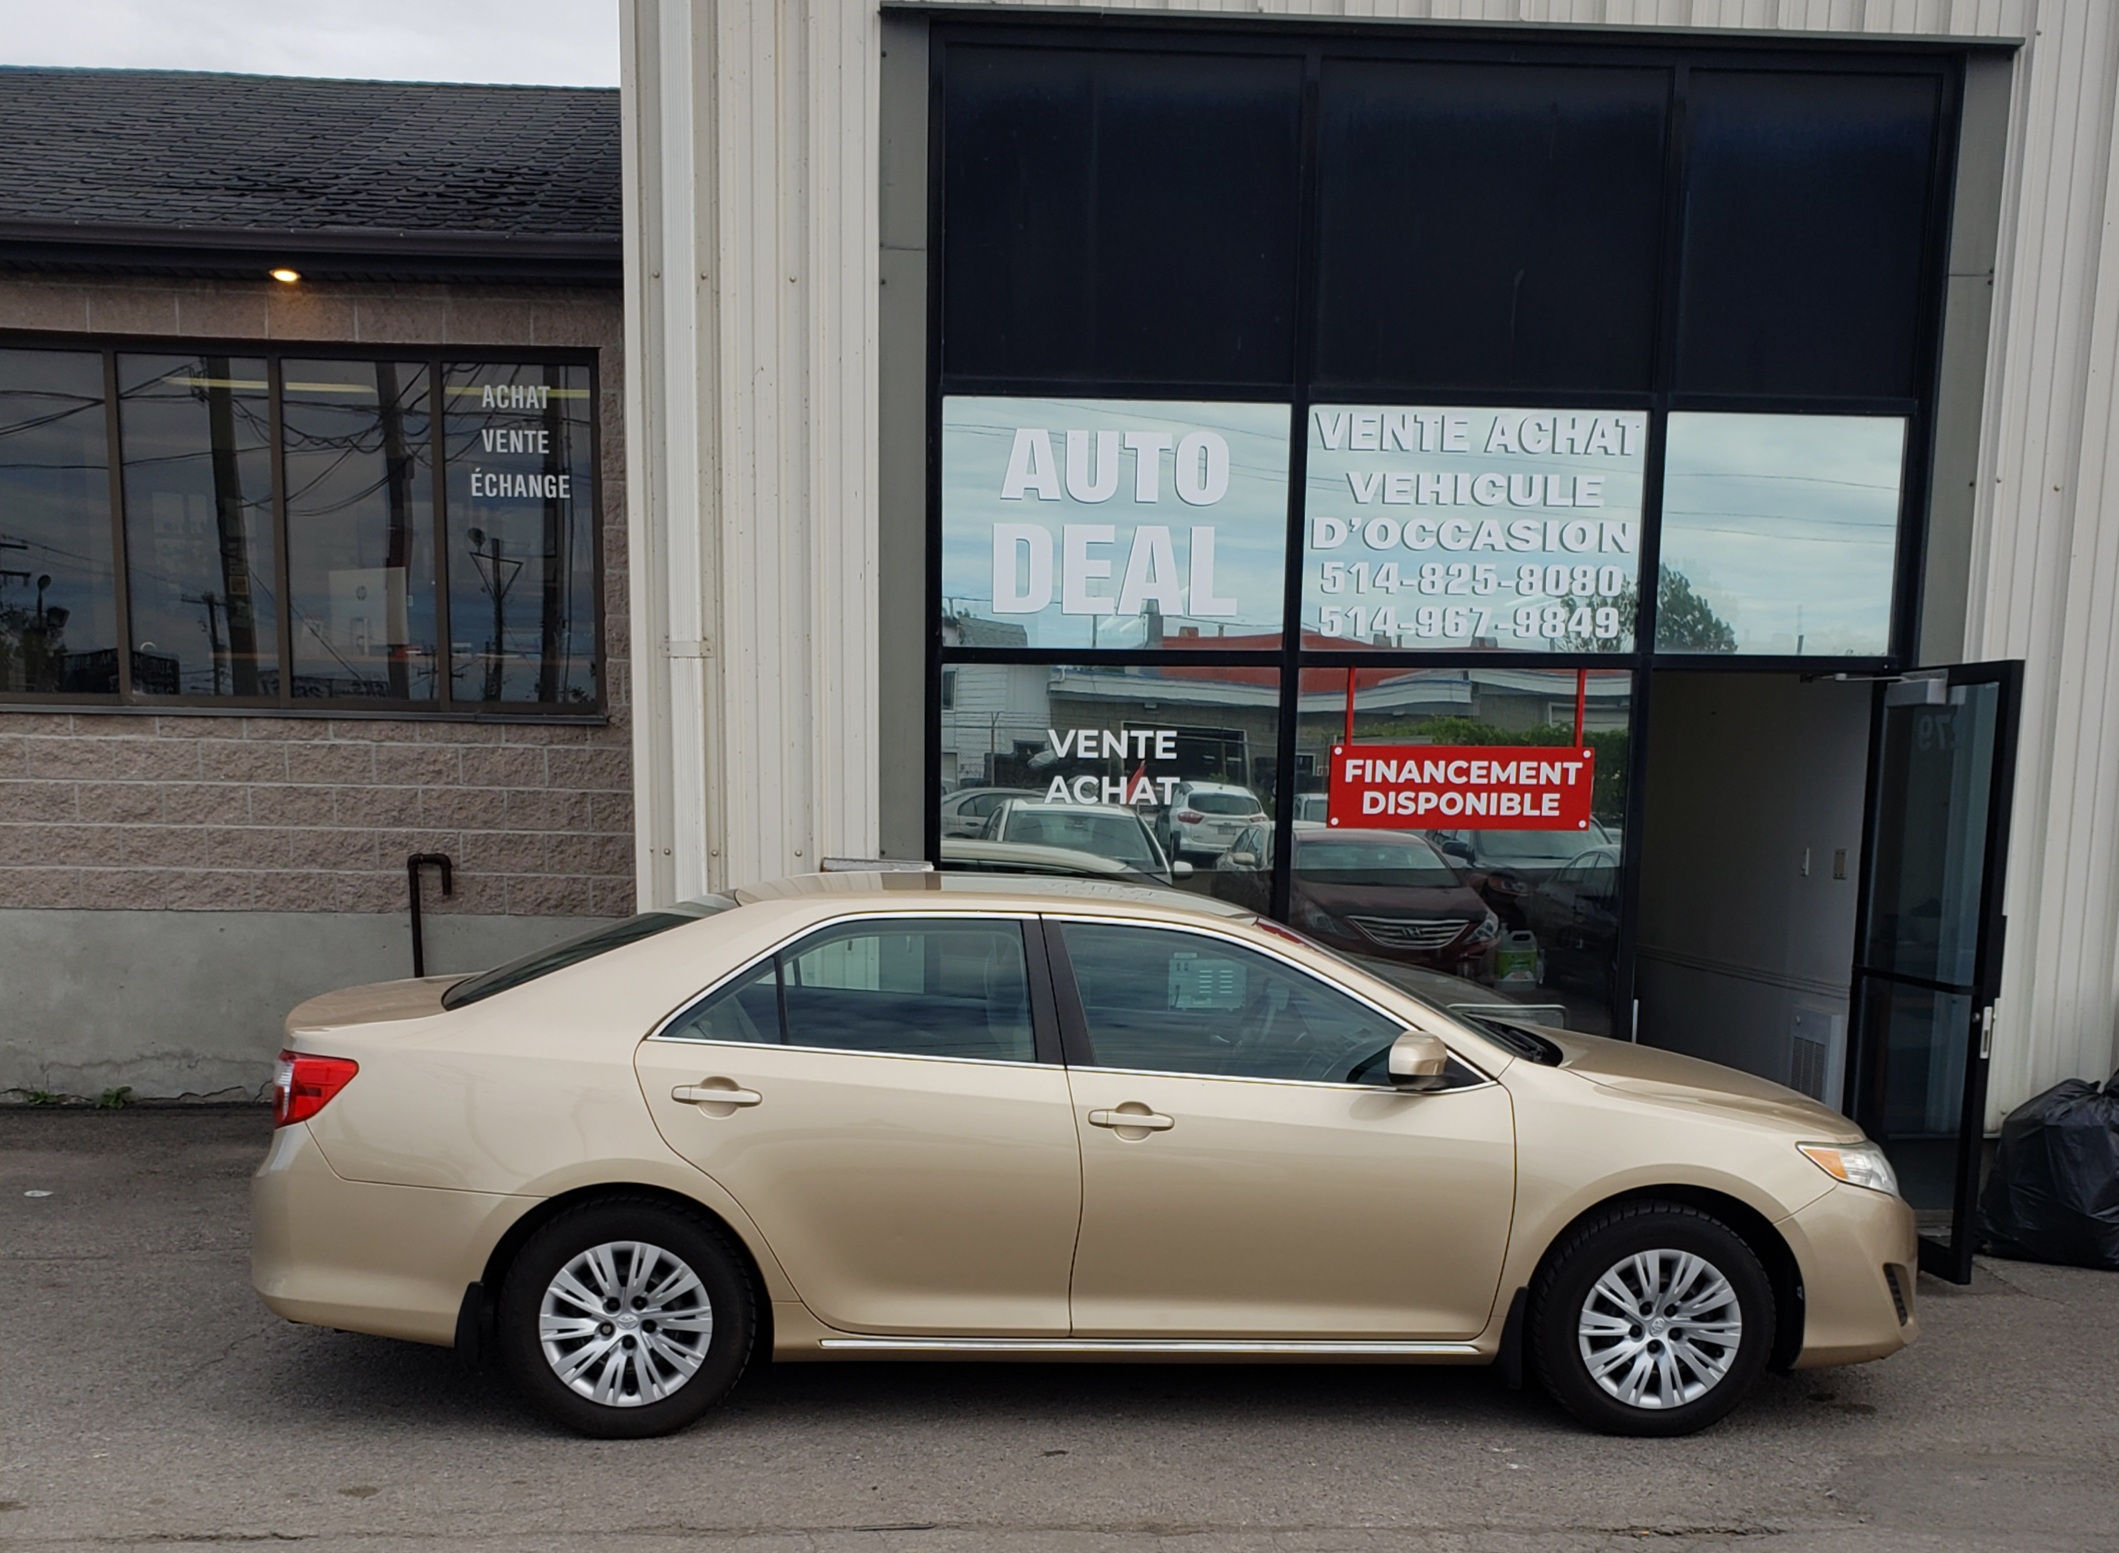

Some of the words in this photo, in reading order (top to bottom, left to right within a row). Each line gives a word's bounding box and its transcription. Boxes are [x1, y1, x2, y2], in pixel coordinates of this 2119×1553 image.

[482, 385, 551, 409] ACHAT
[482, 429, 550, 454] VENTE
[1315, 412, 1471, 452] VENTE
[1484, 415, 1641, 456] ACHAT
[471, 467, 571, 498] ÉCHANGE
[1000, 428, 1230, 506] AUTO
[1346, 472, 1605, 508] VEHICULE
[992, 522, 1238, 617] DEAL
[1321, 561, 1624, 598] 514-825-8080
[1318, 605, 1620, 639] 514-967-9849
[1048, 729, 1178, 760] VENTE
[1345, 759, 1583, 785] FINANCEMENT
[1043, 775, 1181, 805] ACHAT
[1362, 791, 1561, 817] DISPONIBLE
